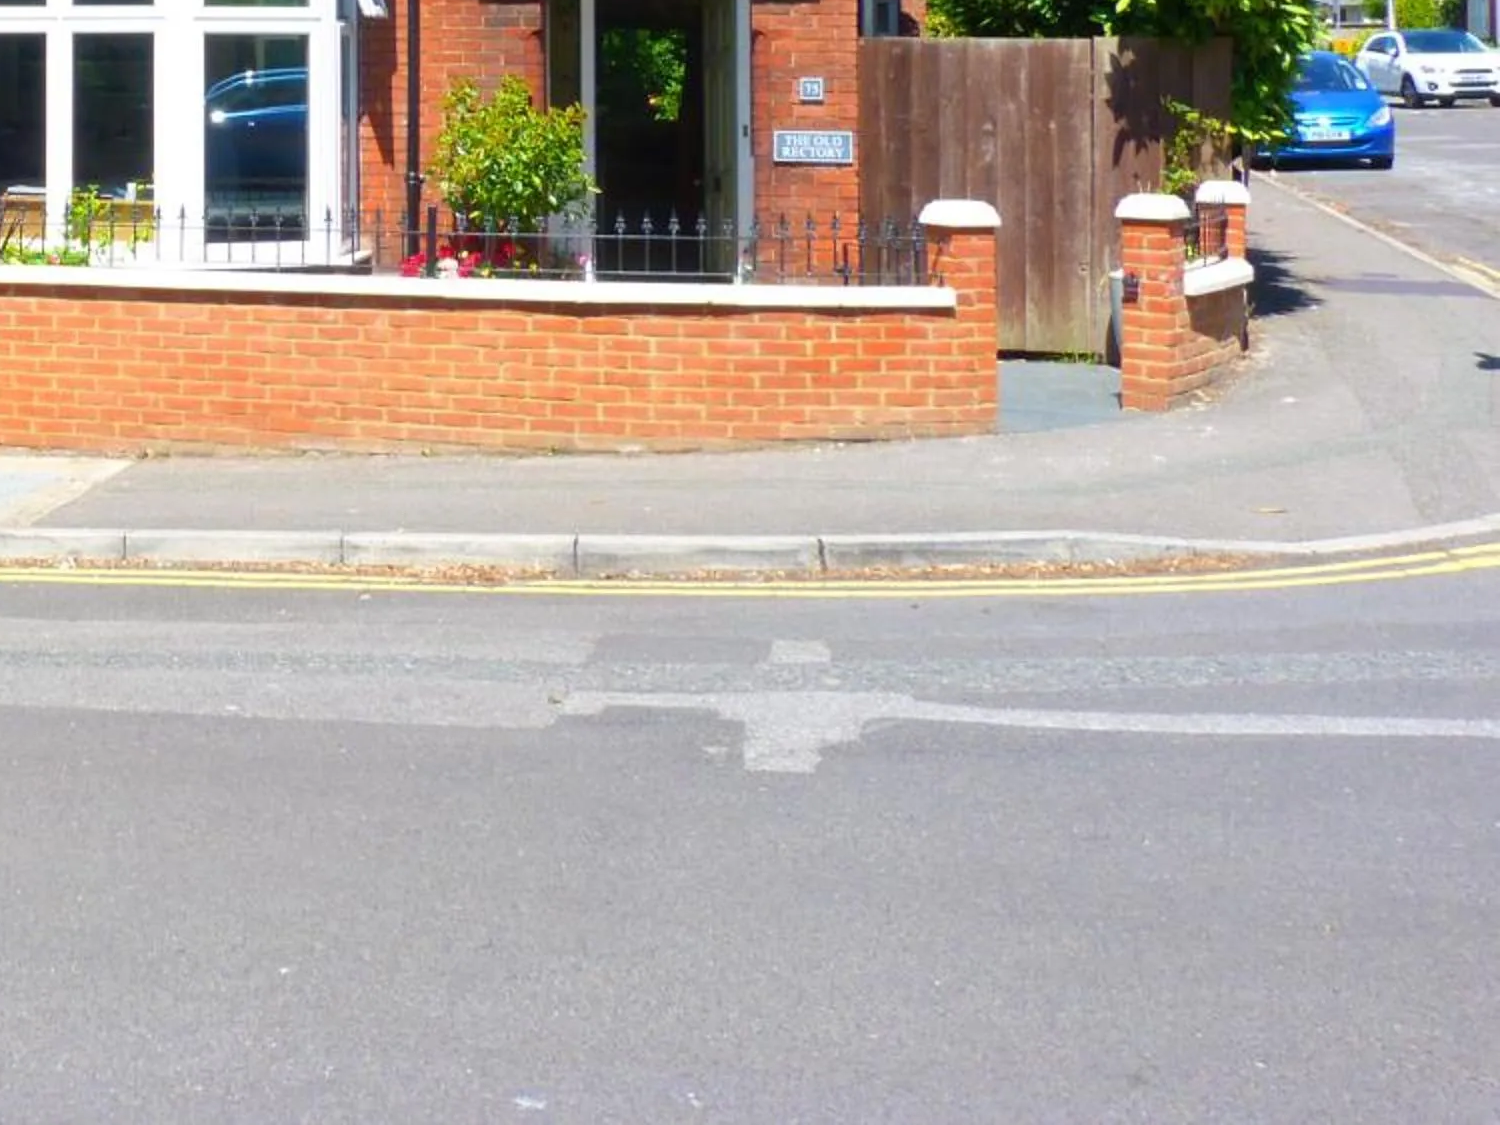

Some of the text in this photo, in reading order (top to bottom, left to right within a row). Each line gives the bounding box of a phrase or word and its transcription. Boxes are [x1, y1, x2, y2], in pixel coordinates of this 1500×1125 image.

[784, 134, 843, 147] THE OLD
[781, 146, 845, 158] RECTORY
